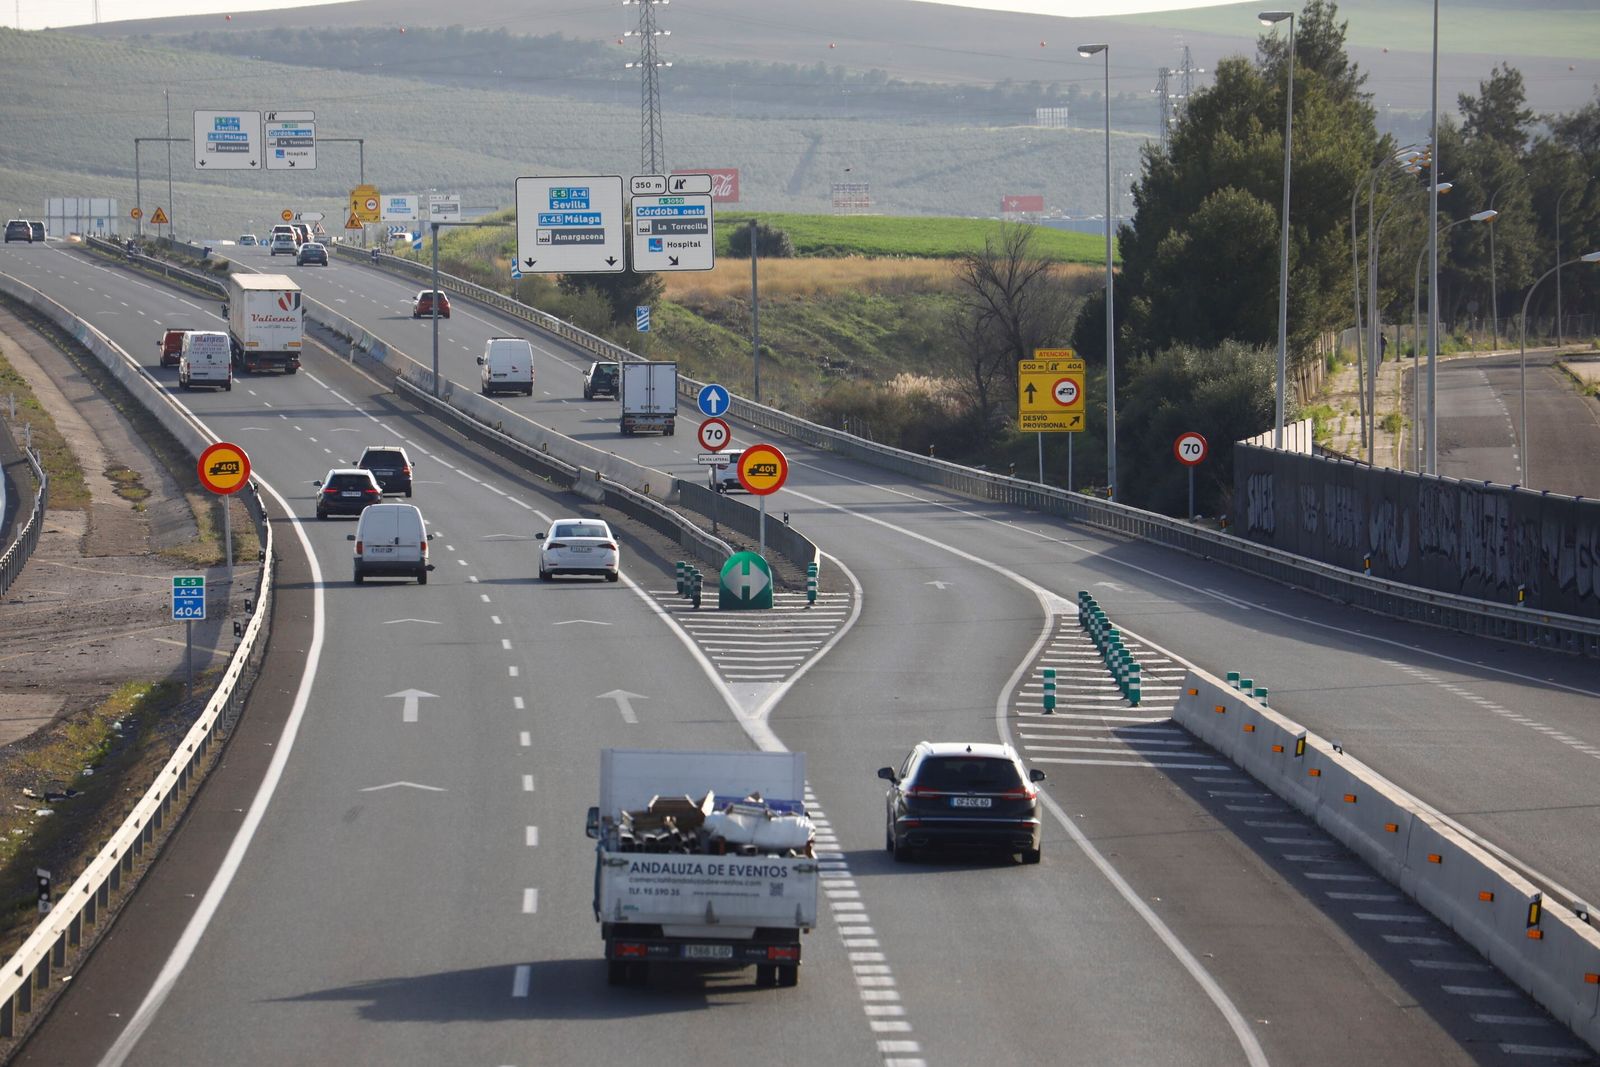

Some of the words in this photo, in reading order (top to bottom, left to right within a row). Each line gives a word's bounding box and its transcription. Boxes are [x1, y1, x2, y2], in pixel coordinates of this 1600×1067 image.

[552, 190, 566, 198] E-5
[552, 200, 587, 209] Sevilla
[637, 206, 679, 216] Córdoba
[541, 215, 561, 223] A-45
[565, 213, 600, 225] Málaga
[657, 223, 667, 231] La
[671, 222, 707, 230] Torrecilla
[554, 233, 604, 241] Amargacena
[666, 240, 701, 249] Hospital
[251, 313, 297, 323] Valiente
[706, 429, 723, 440] 70
[1183, 443, 1200, 455] 70
[220, 463, 237, 471] 40t
[758, 464, 775, 473] 40t
[181, 578, 197, 586] E-5
[180, 588, 198, 596] A-4
[175, 606, 202, 617] 404
[629, 861, 703, 876] ANDALUZA
[708, 863, 726, 876] DE
[729, 864, 788, 878] EVENTOS
